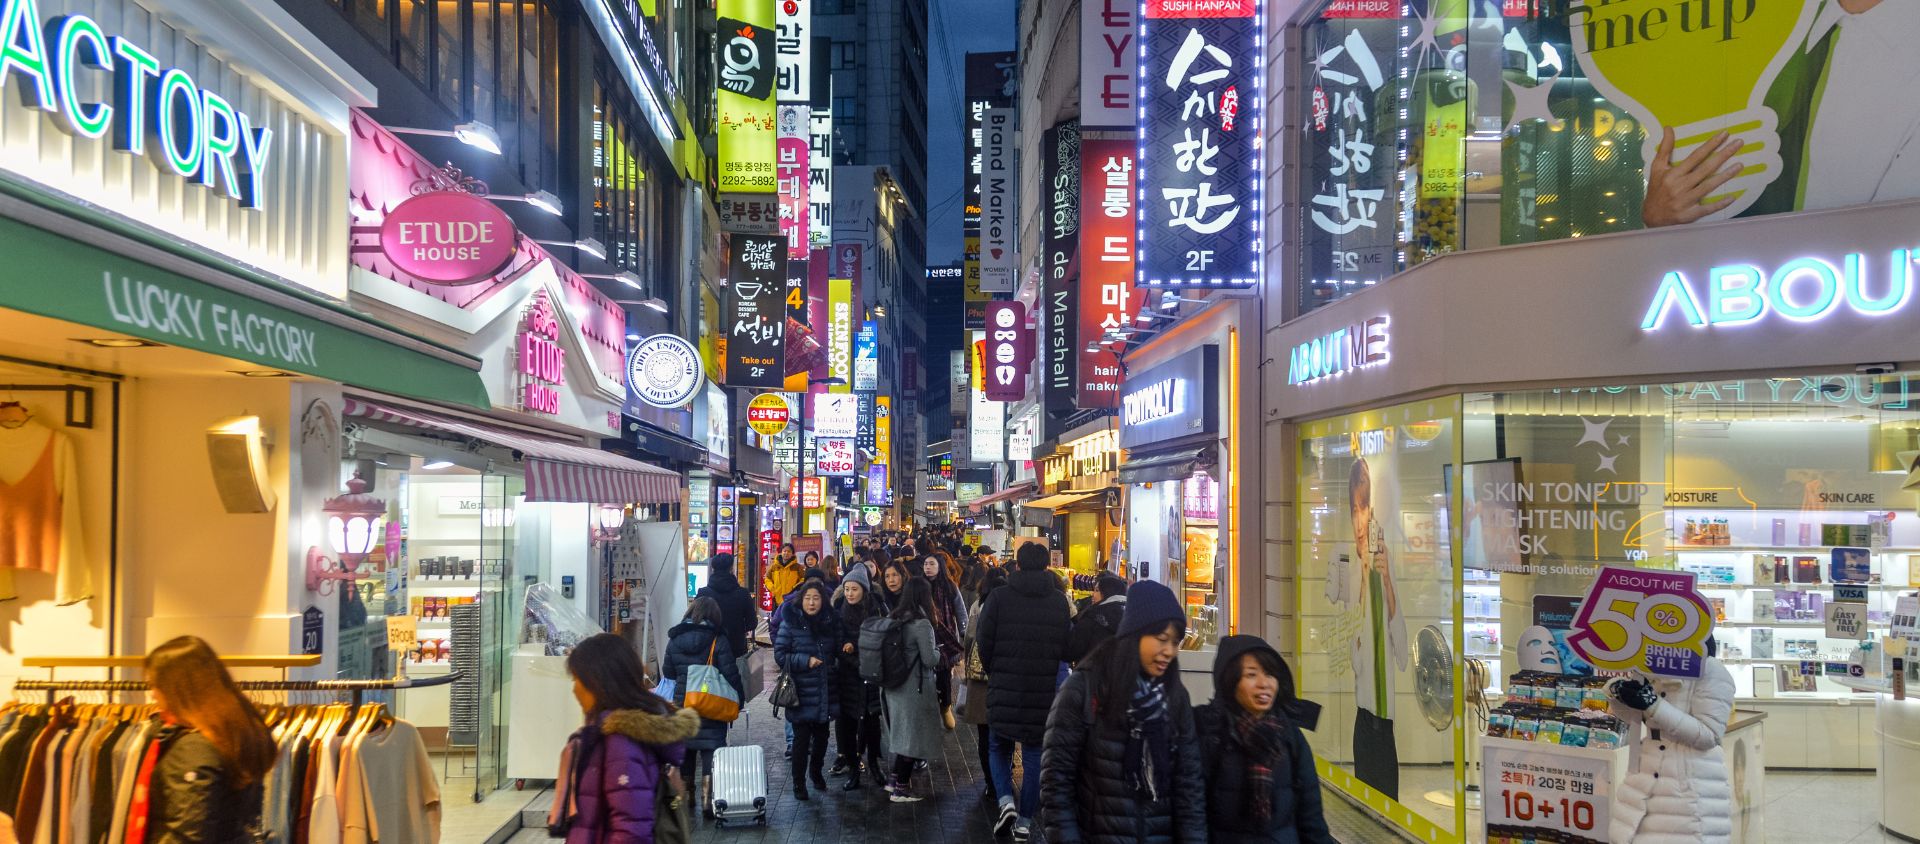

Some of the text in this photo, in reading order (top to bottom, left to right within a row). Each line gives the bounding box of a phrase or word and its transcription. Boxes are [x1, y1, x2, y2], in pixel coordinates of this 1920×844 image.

[1162, 0, 1241, 11] SUSHI HANPAN
[1582, 0, 1758, 54] me up
[725, 162, 772, 172] 명동중앙점
[722, 175, 775, 186] 2292-5892
[990, 114, 1006, 247] Brand Market
[732, 201, 778, 222] 부동산
[398, 221, 495, 245] ETUDE
[745, 239, 777, 253] 코리안
[1101, 236, 1131, 262] 드
[413, 246, 482, 262] HOUSE
[742, 251, 774, 262] 디저트
[1186, 251, 1214, 271] 2F
[751, 260, 776, 271] 카페
[931, 268, 962, 278] 신한은행
[1053, 174, 1069, 389] Salon de Marshall
[1640, 247, 1920, 332] ABOU
[102, 271, 318, 369] LUCKY FACTORY
[734, 314, 783, 347] 설빙
[1288, 315, 1391, 386] ABOUT ME
[520, 332, 566, 386] ETUDE
[635, 342, 693, 375] EDIYA ESPRESSO
[741, 356, 760, 365] Take
[751, 367, 765, 377] 2F
[1095, 365, 1119, 376] hair
[525, 382, 562, 416] HOUSE
[645, 385, 682, 399] COFFEE
[857, 401, 869, 435] 돈까스
[818, 460, 853, 473] 떡볶이
[1482, 482, 1649, 504] SKIN TONE UP
[1662, 491, 1719, 504] MOISTURE
[1819, 492, 1876, 504] SKIN CARE
[459, 500, 486, 510] Men
[1549, 562, 1598, 576] solution
[1608, 574, 1685, 591] ABOUT ME
[1839, 589, 1865, 598] VISA
[1836, 625, 1856, 633] FREE
[1839, 618, 1854, 626] TAX
[305, 630, 318, 651] 20
[1646, 644, 1692, 659] BRAND
[1644, 656, 1691, 671] SALE
[1501, 770, 1594, 796] 초특가 20장 만원
[1501, 789, 1594, 831] 10+10
